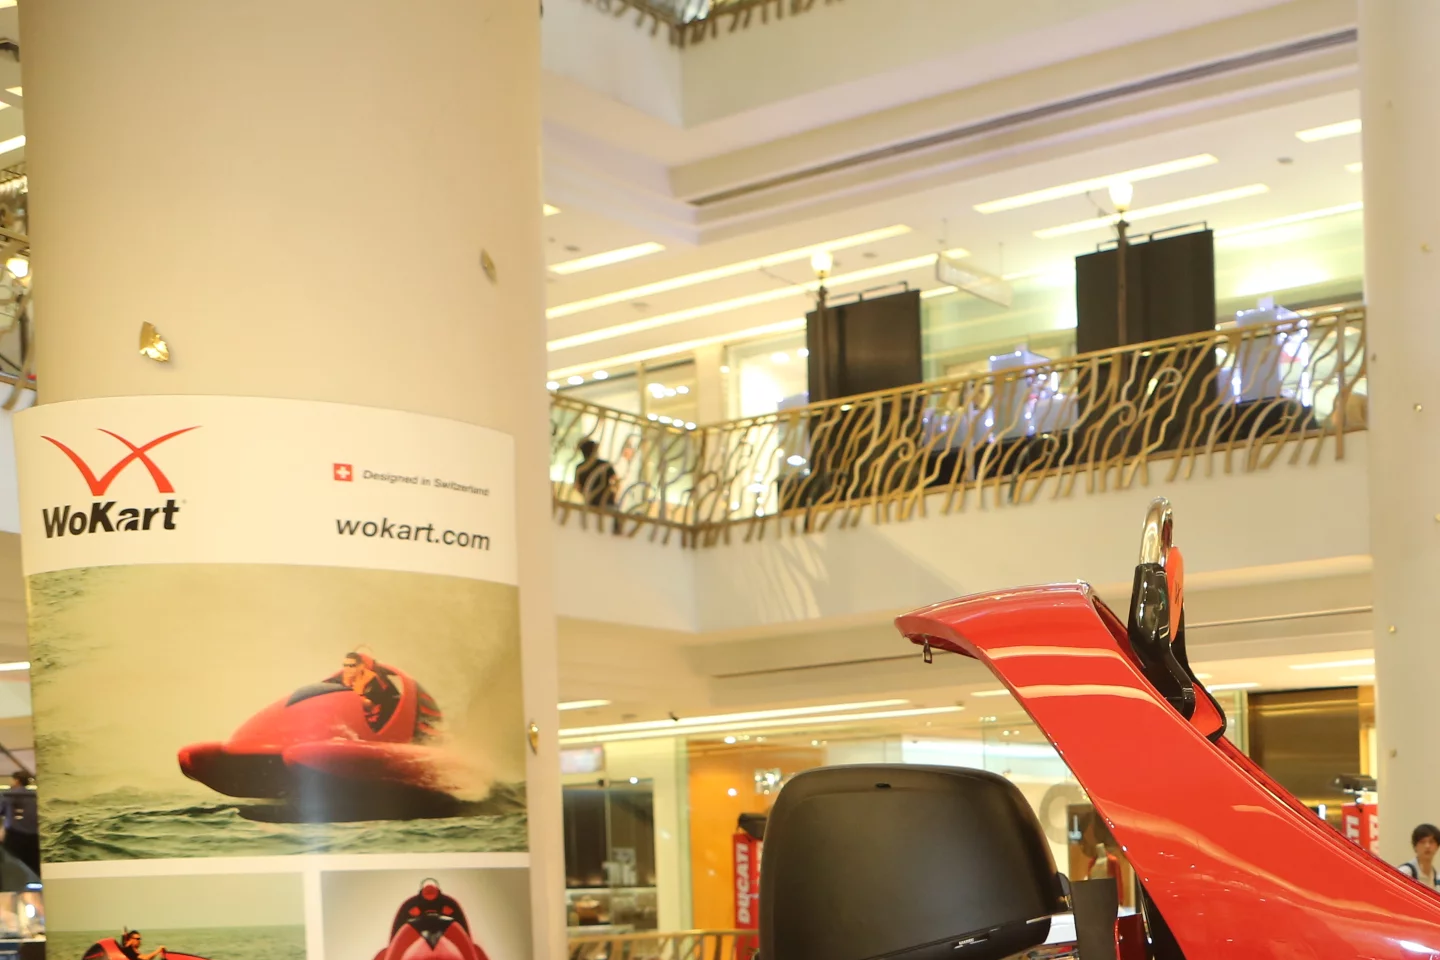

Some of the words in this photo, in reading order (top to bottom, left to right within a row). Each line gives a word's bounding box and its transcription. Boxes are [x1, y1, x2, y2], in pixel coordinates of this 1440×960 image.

[362, 470, 418, 484] Designed
[421, 476, 431, 486] in
[434, 478, 490, 496] Switzerland
[42, 499, 180, 539] WoKart
[336, 517, 490, 551] wokart.com
[736, 842, 751, 925] DUCATI
